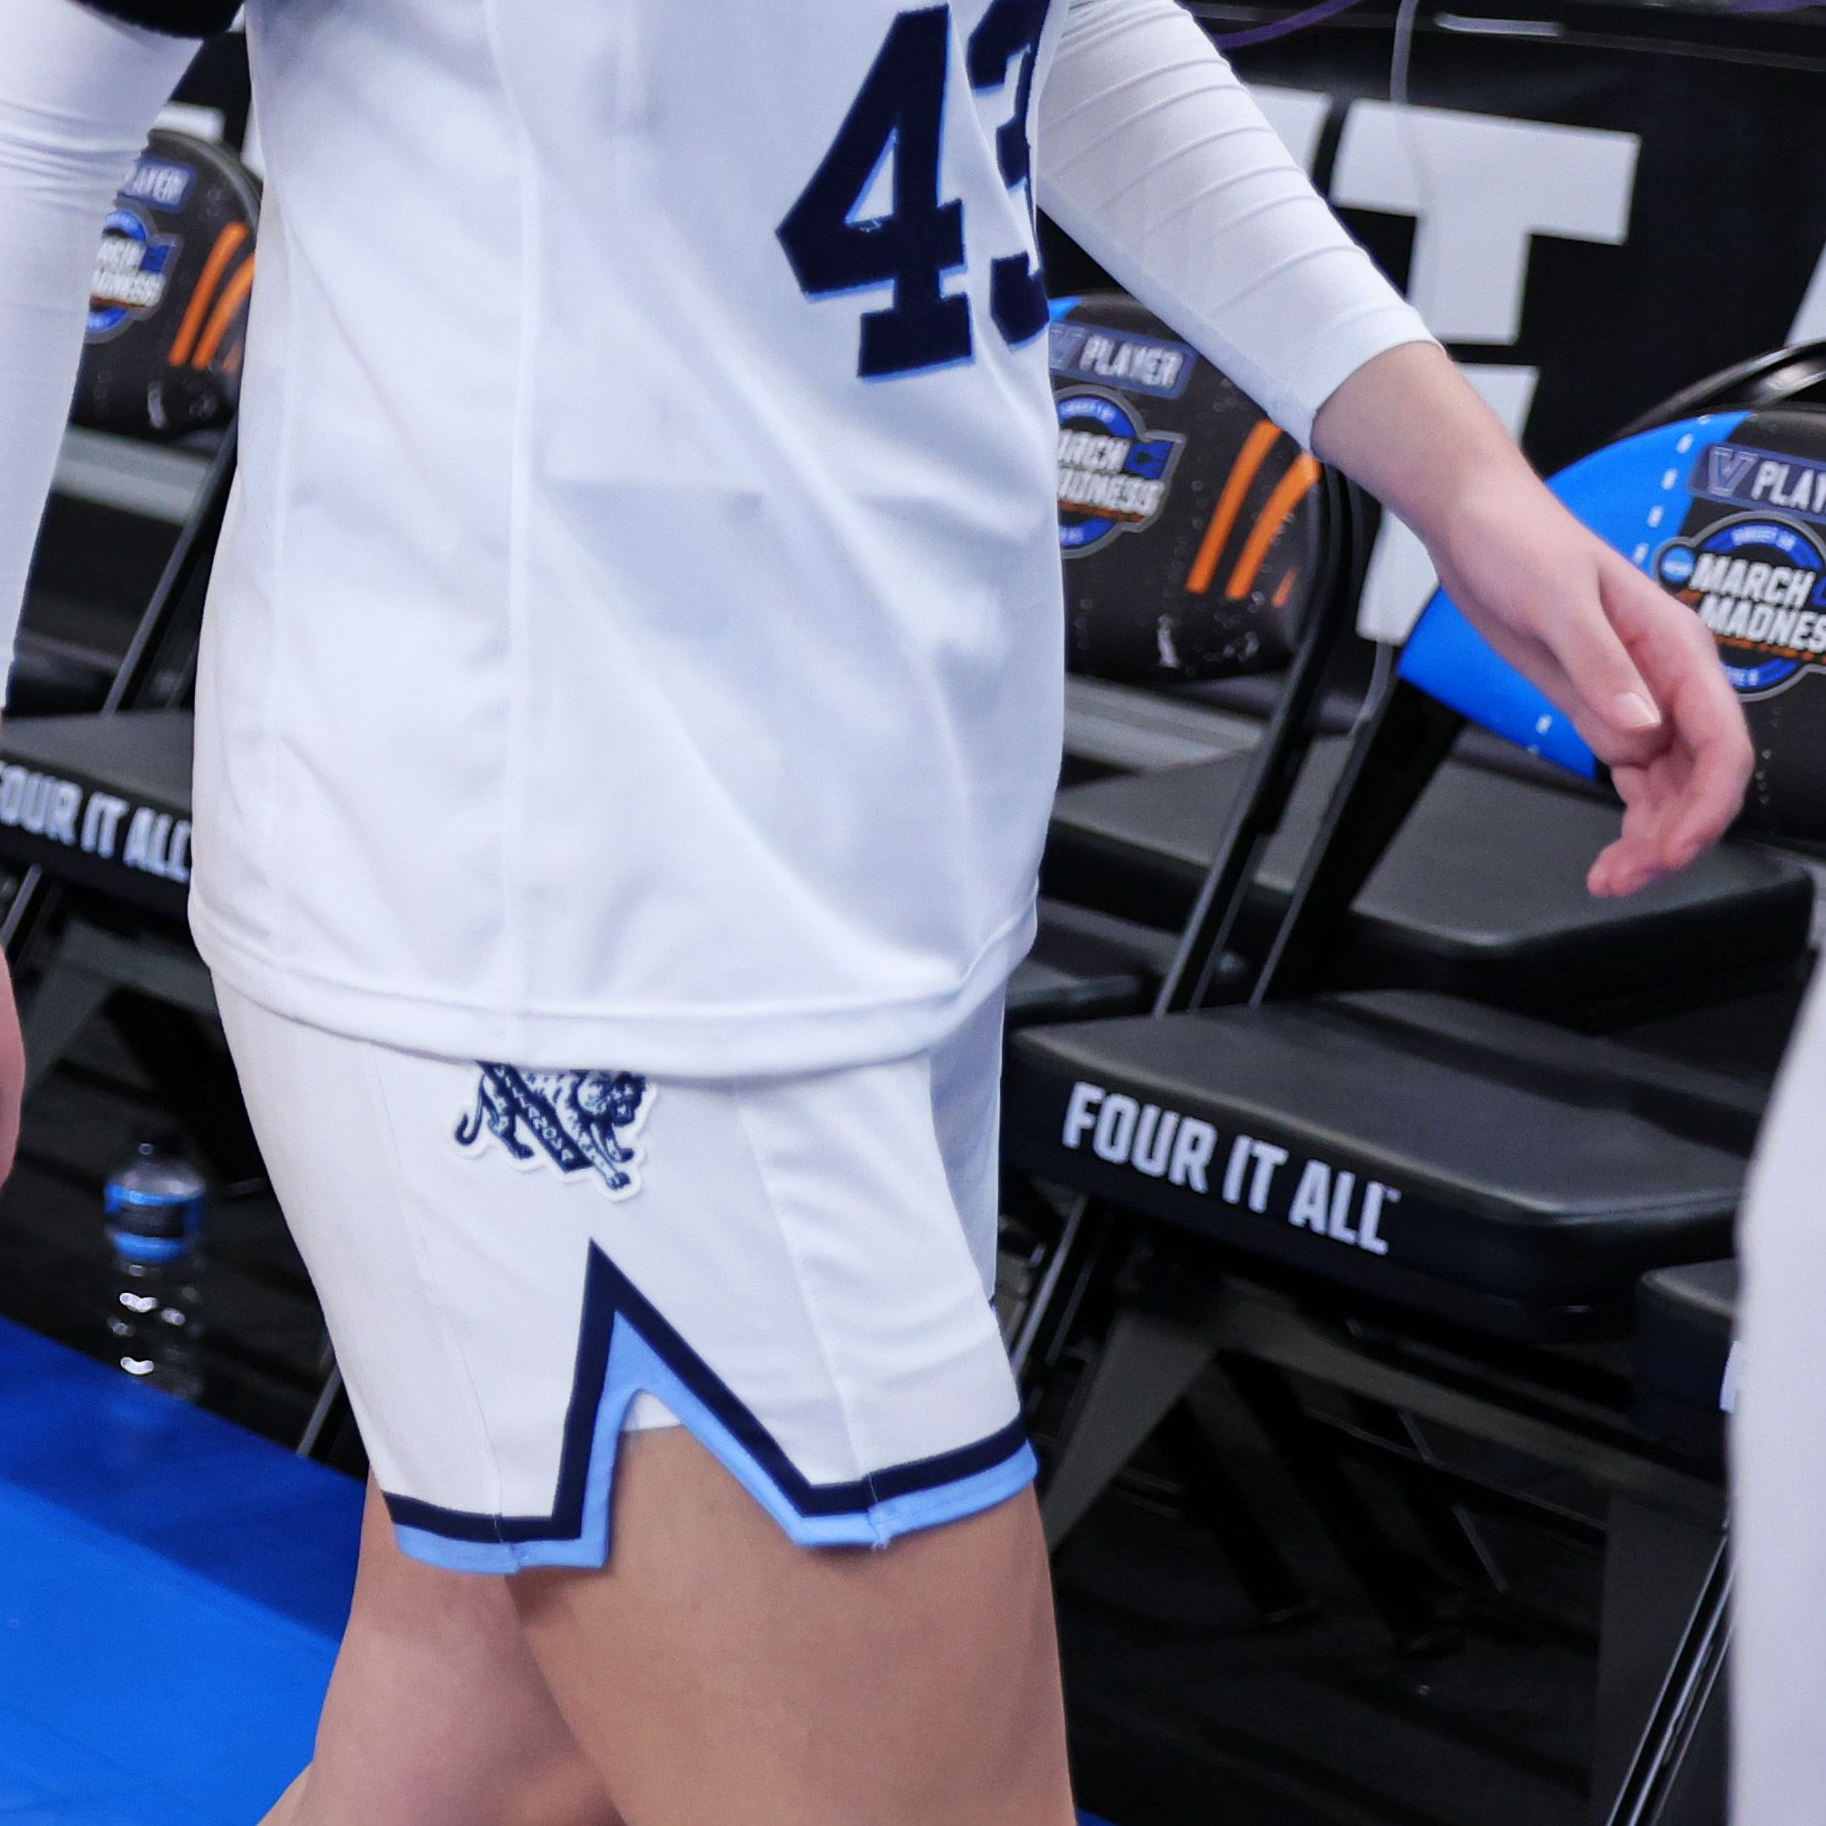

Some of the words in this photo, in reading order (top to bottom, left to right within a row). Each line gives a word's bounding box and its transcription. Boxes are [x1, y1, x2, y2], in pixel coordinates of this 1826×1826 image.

[1078, 334, 1184, 389] PLAYER
[1689, 552, 1817, 611] MARCH
[80, 791, 131, 860] IT
[122, 806, 192, 885] ALL
[493, 1064, 575, 1162] VILLANOVA
[1061, 1080, 1218, 1195] FOUR
[1221, 1133, 1290, 1214] IT
